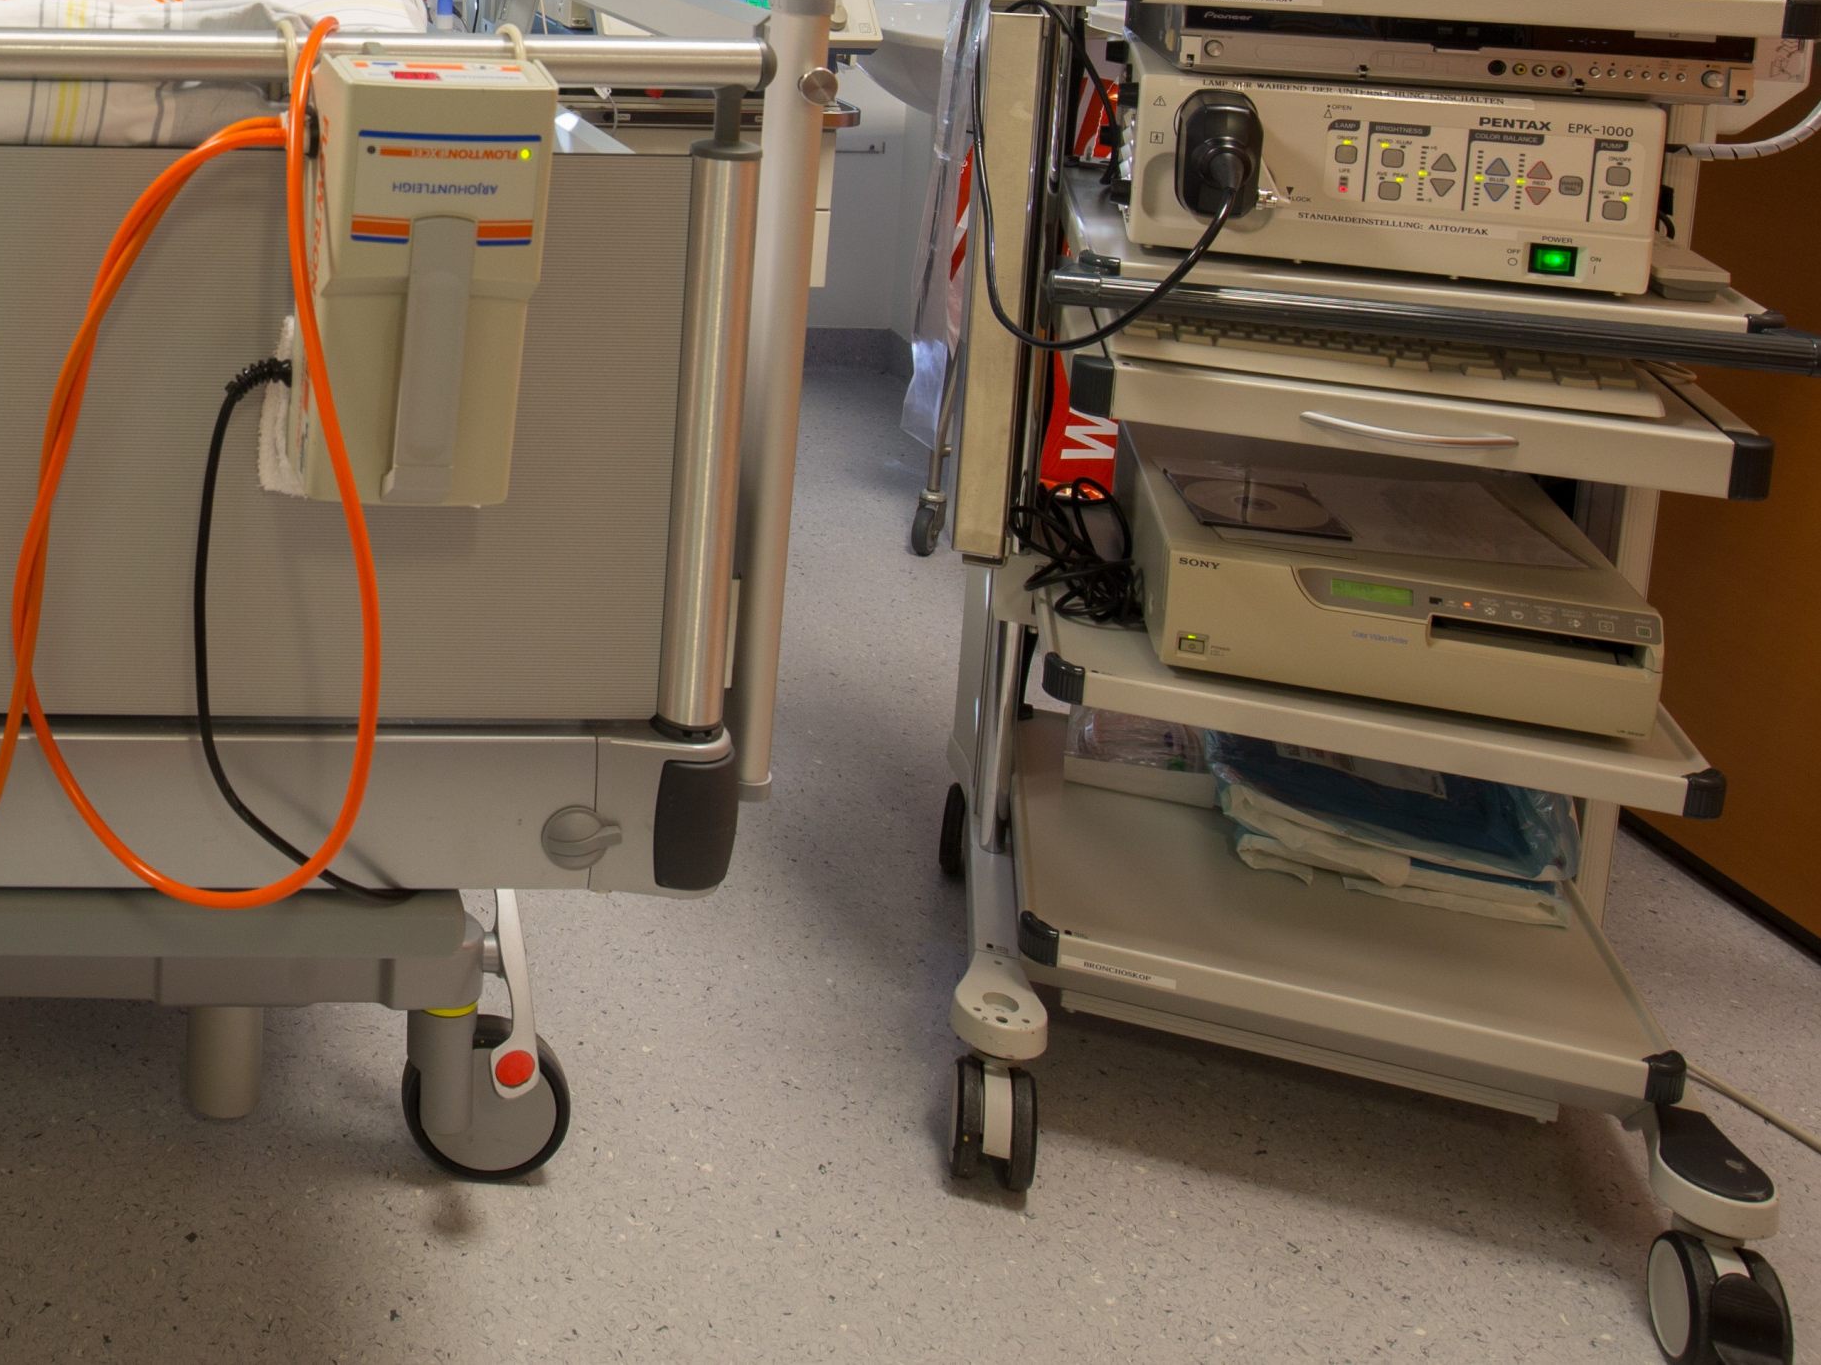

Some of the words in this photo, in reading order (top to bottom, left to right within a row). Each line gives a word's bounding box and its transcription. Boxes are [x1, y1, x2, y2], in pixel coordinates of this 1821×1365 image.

[1204, 11, 1253, 21] Pioneer
[1202, 79, 1229, 87] LAMP
[1312, 85, 1332, 93] DER
[1375, 125, 1423, 135] BRIGHTNESS
[1479, 117, 1551, 131] PENTAX
[1568, 123, 1634, 137] EPK-1000
[1475, 132, 1500, 140] COLOR
[1503, 134, 1539, 144] BALANCE
[392, 182, 498, 195] ARJOHUNTLEIGH
[1297, 211, 1424, 230] STANDARDEINSTELLUNG:
[1428, 224, 1489, 236] AUTO/PEAK
[1541, 235, 1574, 244] POWER
[1590, 256, 1602, 264] ON
[1179, 557, 1220, 570] SONY
[1083, 961, 1152, 981] BRONCHOSKOP
